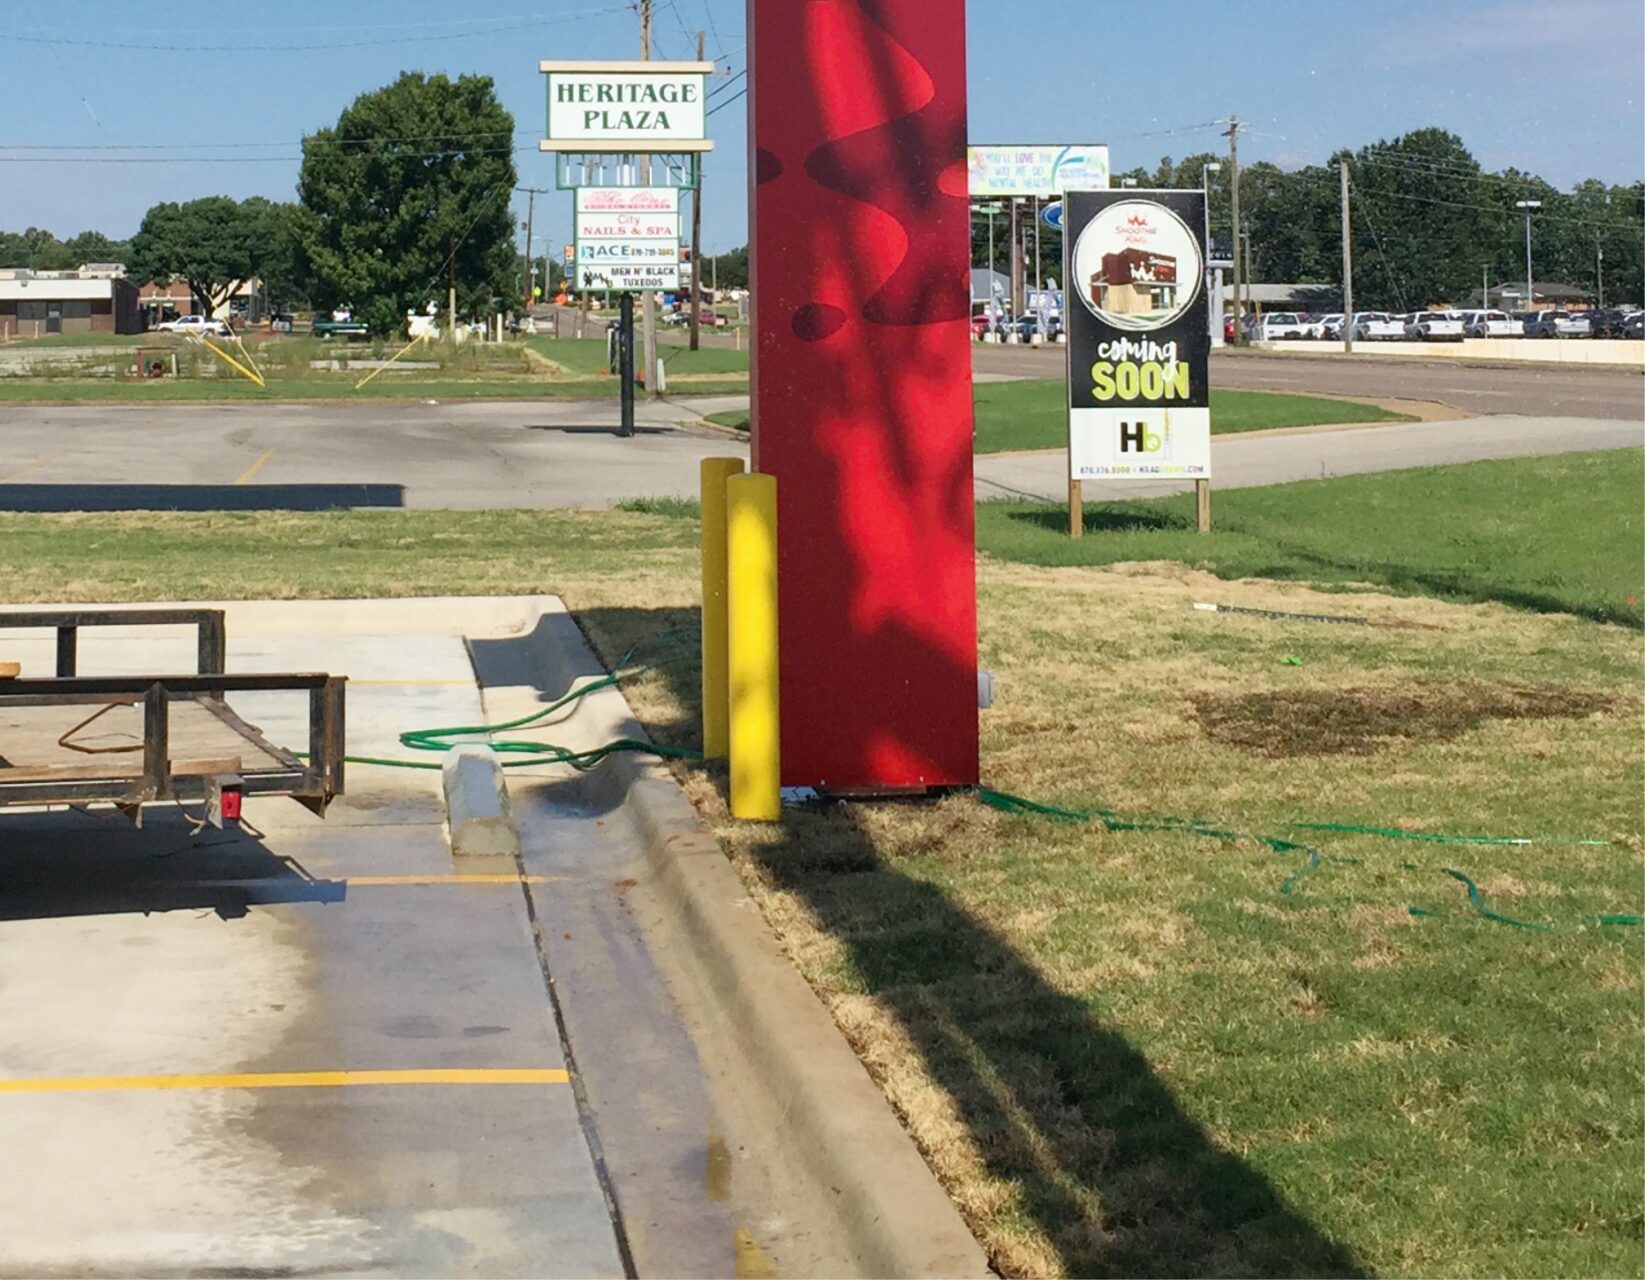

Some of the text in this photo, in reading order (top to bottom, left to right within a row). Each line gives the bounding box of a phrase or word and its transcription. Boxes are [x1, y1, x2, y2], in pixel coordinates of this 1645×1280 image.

[556, 83, 697, 103] HERITAGE
[583, 110, 672, 130] PLAZA
[1016, 152, 1034, 164] LOVE
[617, 214, 641, 226] City
[583, 226, 673, 235] NAILS & SPA
[611, 267, 631, 276] MEN
[645, 267, 675, 276] BLACK
[623, 278, 664, 287] TUXEDOS
[1097, 334, 1177, 383] coming
[1091, 361, 1190, 401] SOON
